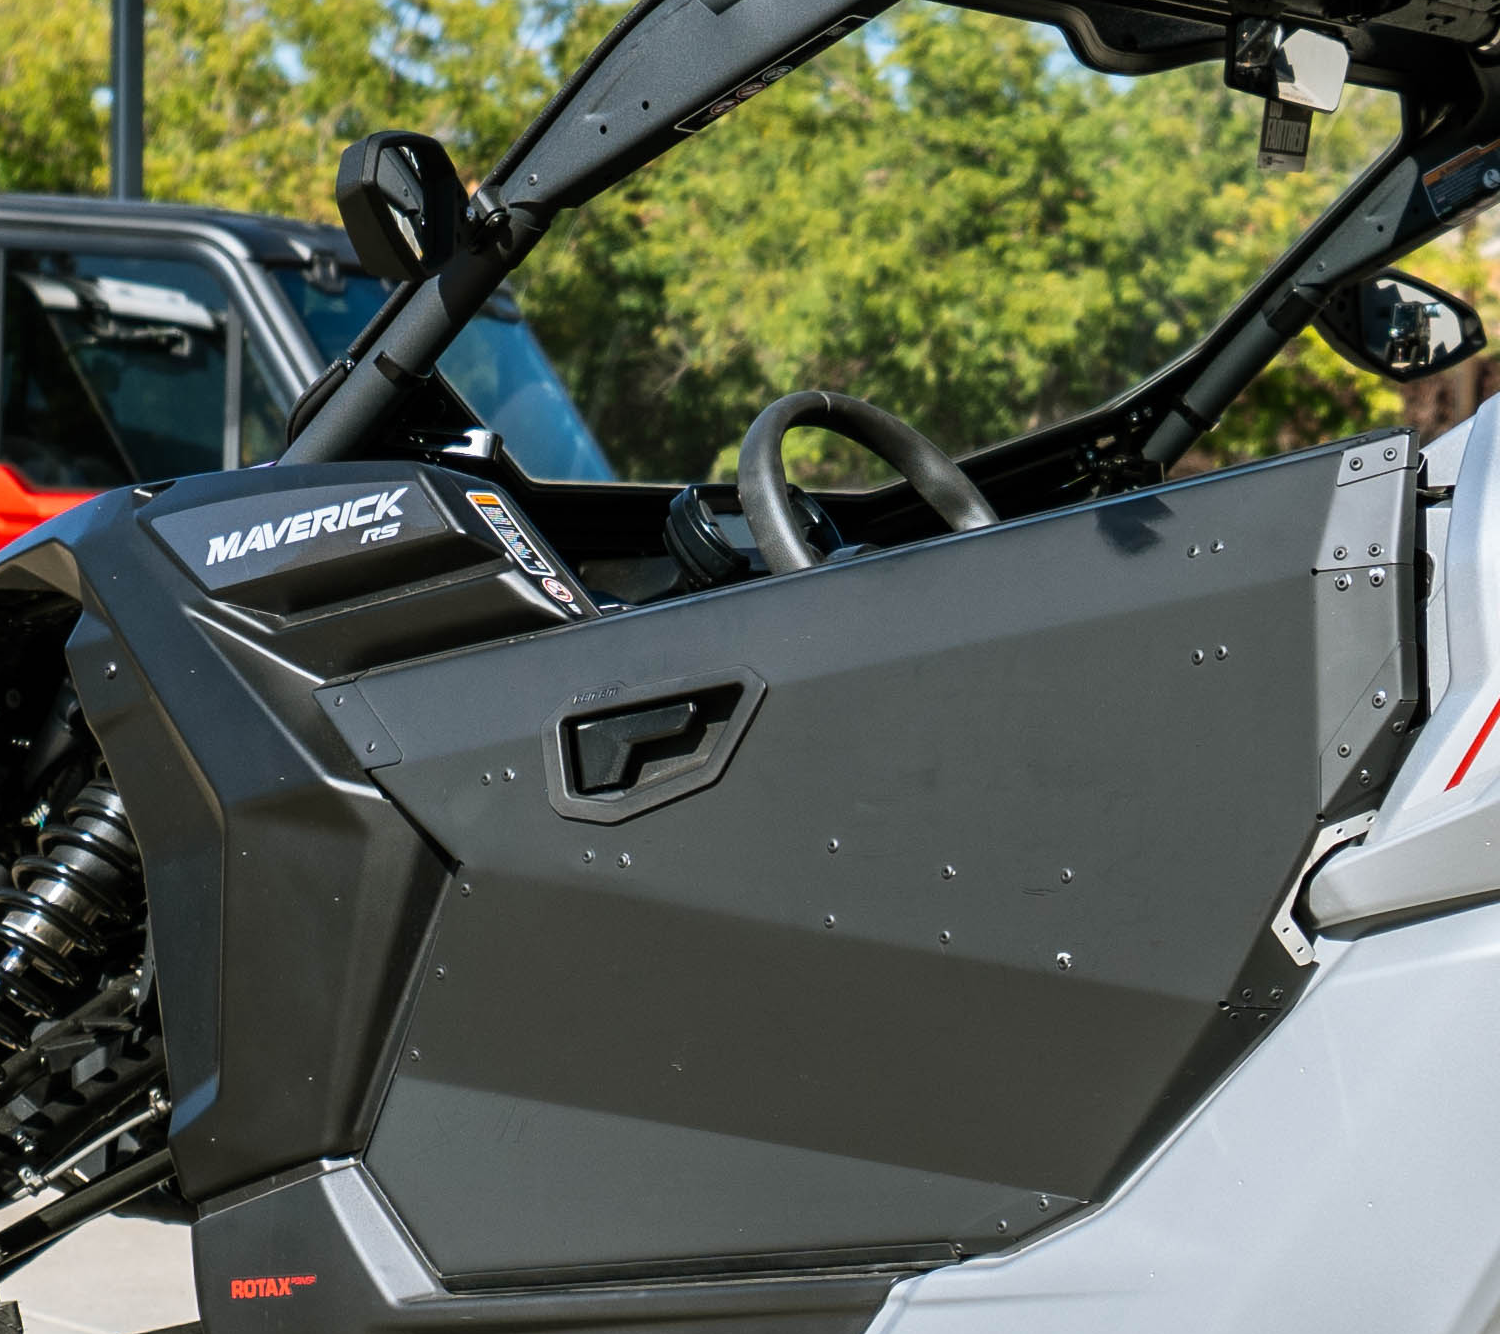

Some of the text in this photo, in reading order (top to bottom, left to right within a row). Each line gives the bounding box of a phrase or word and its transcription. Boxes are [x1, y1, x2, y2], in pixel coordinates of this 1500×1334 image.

[206, 487, 409, 566] MAVERICK
[360, 522, 402, 545] RS
[231, 1277, 292, 1299] ROTAX
